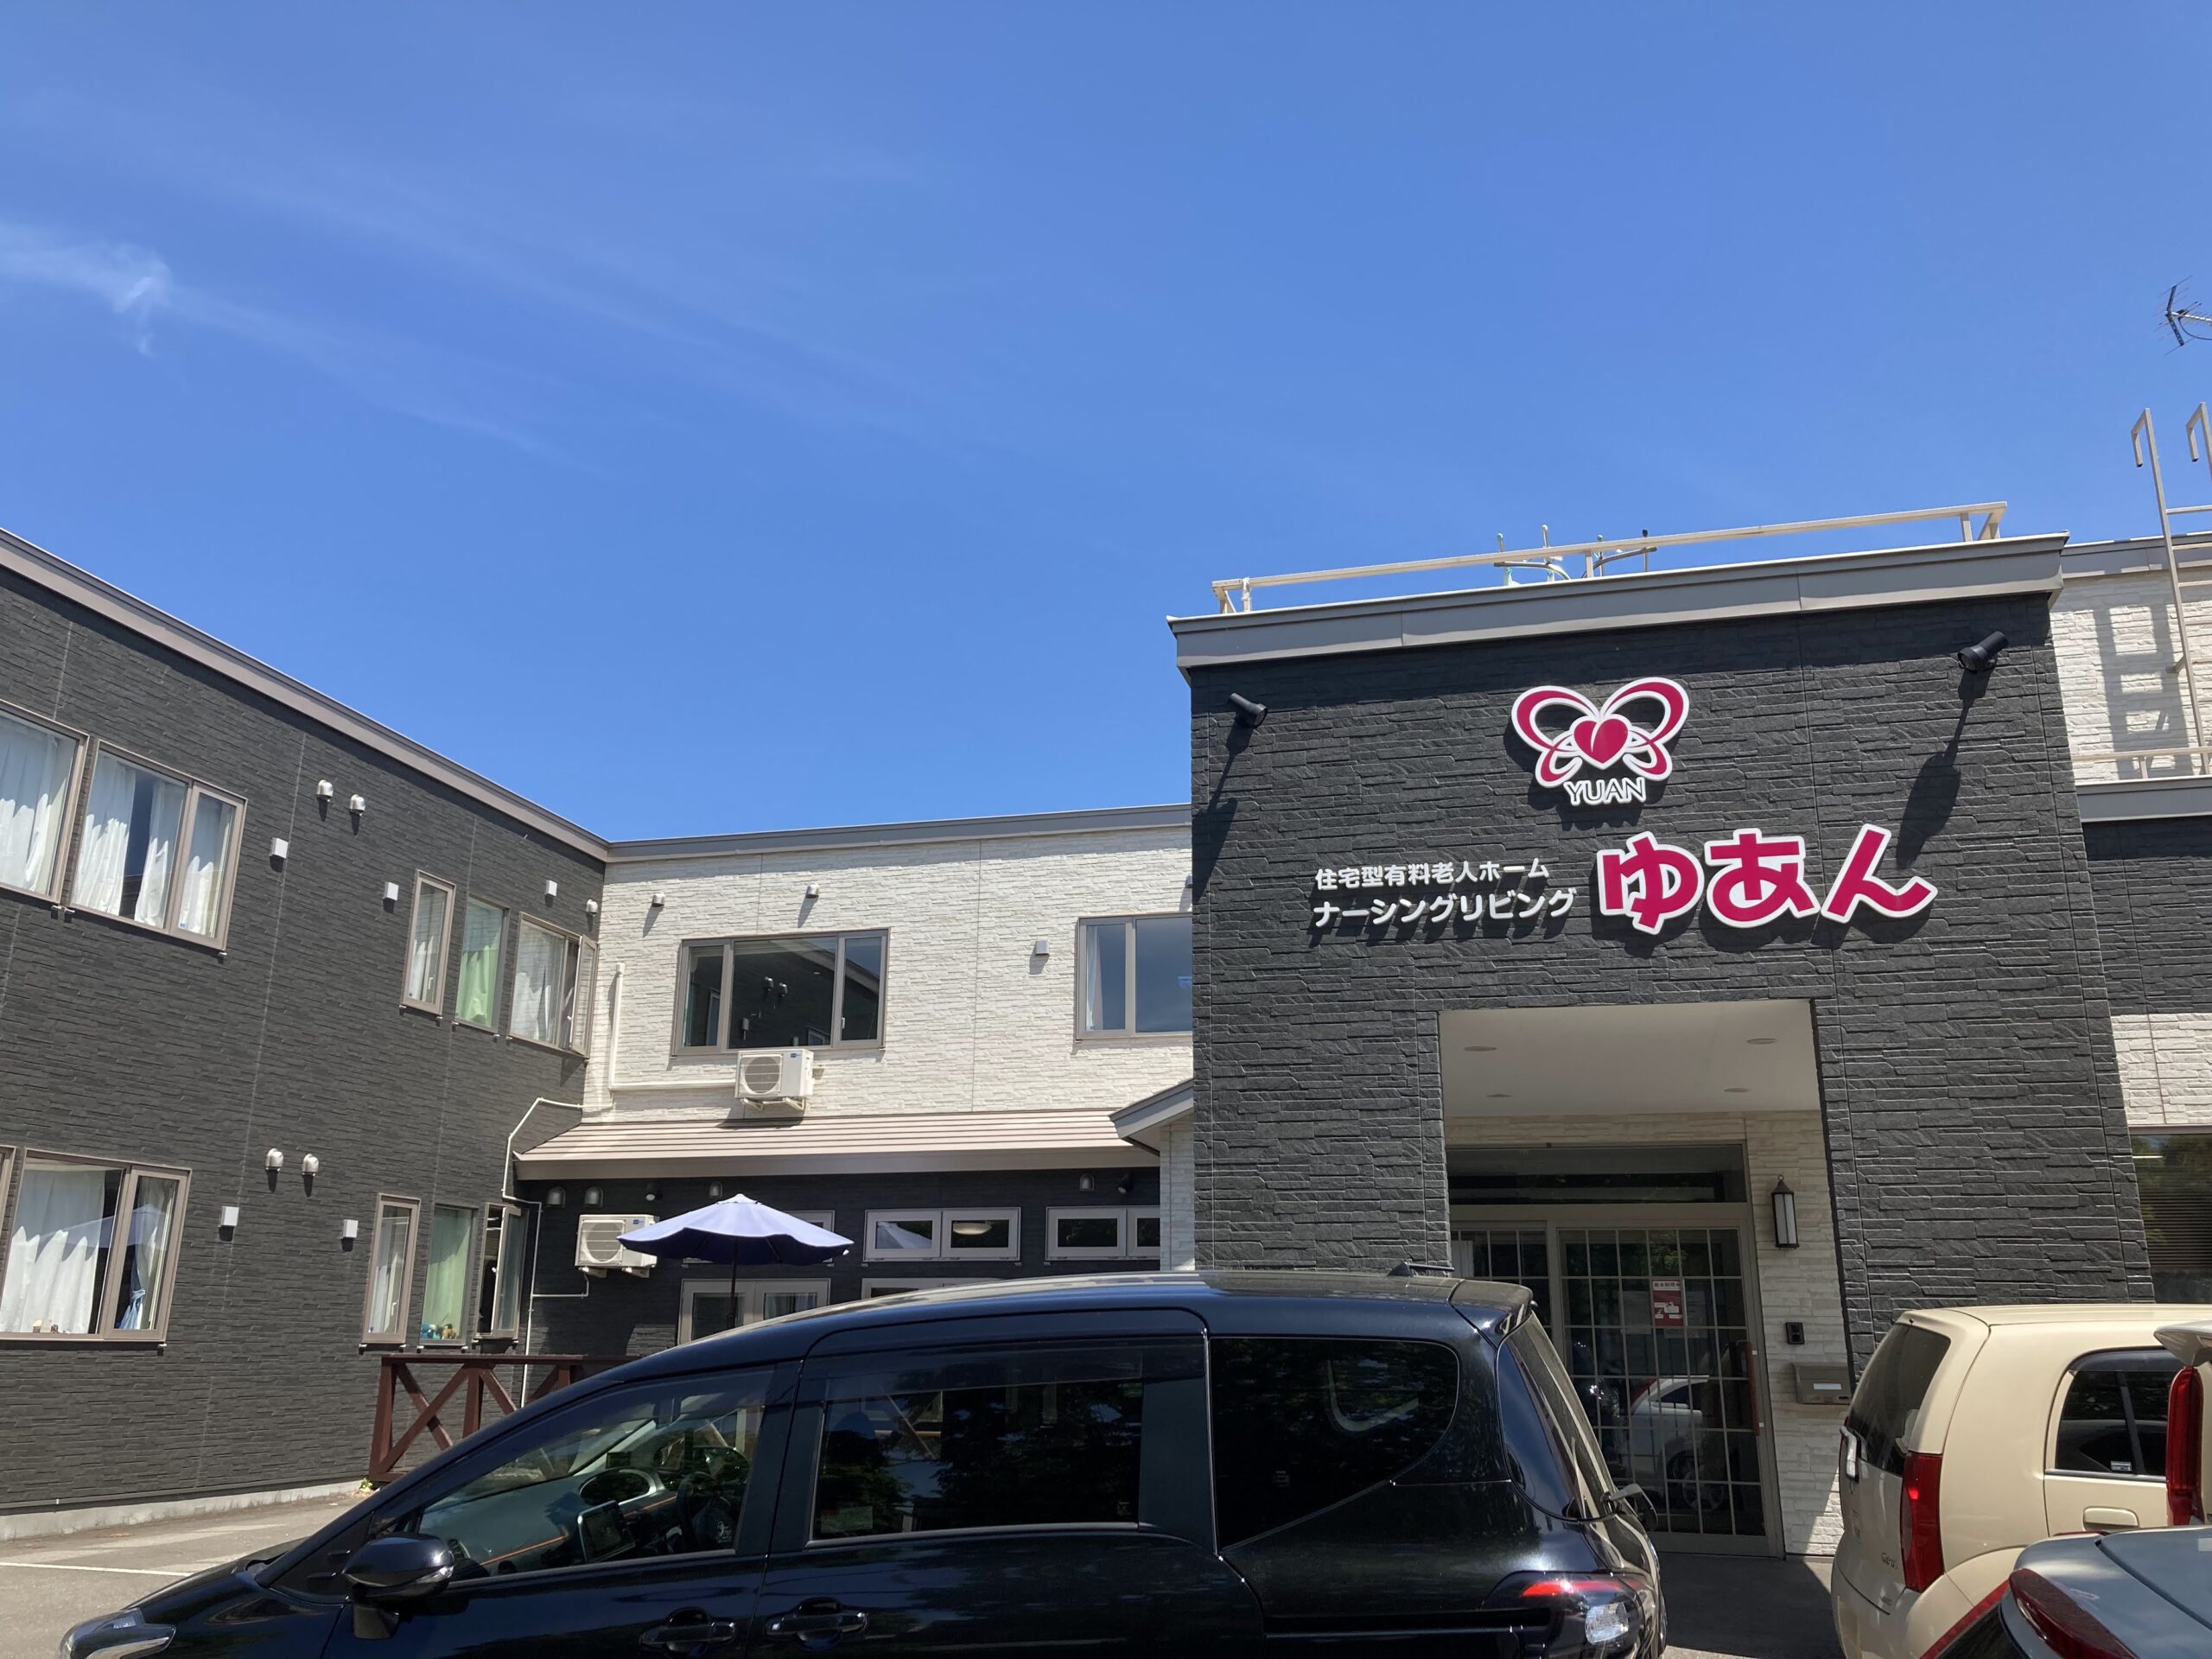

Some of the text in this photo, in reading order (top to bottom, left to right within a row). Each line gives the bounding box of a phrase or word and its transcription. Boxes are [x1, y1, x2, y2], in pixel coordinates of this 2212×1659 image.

[1563, 777, 1647, 806] YUAN
[1315, 858, 1549, 891] 住宅型有料老人ホーム
[1597, 823, 1938, 935] ゆあん
[1313, 887, 1577, 927] ナーシングリビング
